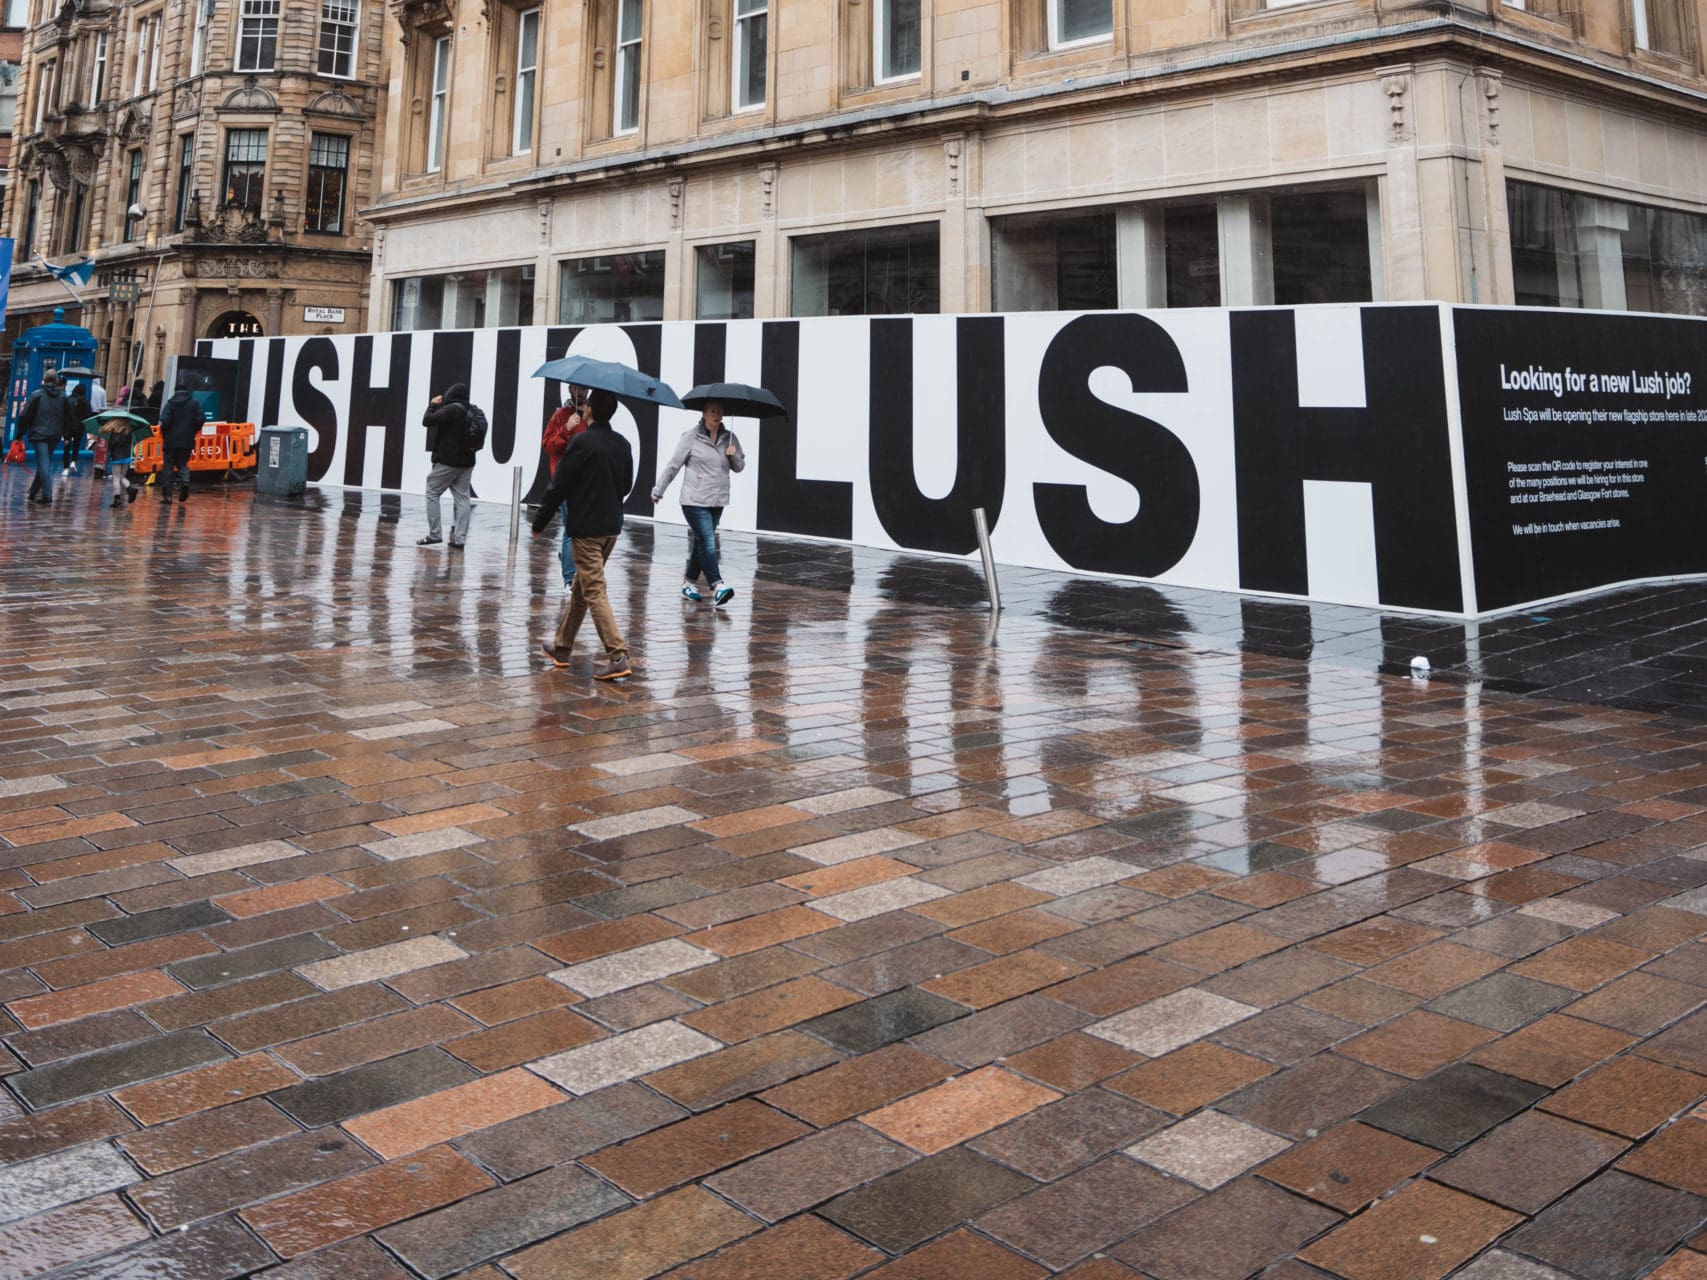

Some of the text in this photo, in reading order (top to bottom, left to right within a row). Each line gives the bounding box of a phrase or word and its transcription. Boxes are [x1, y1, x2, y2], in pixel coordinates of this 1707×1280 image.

[229, 323, 259, 333] THE
[1501, 364, 1692, 400] Looking for a new Lush job?
[1503, 407, 1521, 421] Lush
[1522, 407, 1539, 424] Spa
[1539, 408, 1551, 421] will
[1552, 408, 1562, 421] be
[1563, 408, 1591, 424] opening
[1592, 408, 1607, 421] their
[1608, 410, 1622, 421] new
[1623, 409, 1648, 424] flagship
[1649, 410, 1664, 421] store
[1665, 409, 1680, 421] here
[197, 332, 412, 490] USH
[756, 306, 1463, 612] LUSH
[1507, 461, 1527, 472] Please
[1528, 463, 1541, 472] scan
[1542, 461, 1551, 471] the
[1552, 460, 1561, 471] QR
[1562, 460, 1575, 470] code
[1583, 460, 1601, 472] register
[1602, 461, 1614, 471] your
[1509, 477, 1515, 487] of
[1516, 477, 1525, 487] the
[1526, 479, 1541, 489] many
[1543, 476, 1568, 488] positions
[1511, 493, 1521, 503] and
[1567, 490, 1577, 500] and
[1578, 489, 1600, 501] Glasgow
[1512, 524, 1523, 535] We
[1548, 521, 1564, 532] touch
